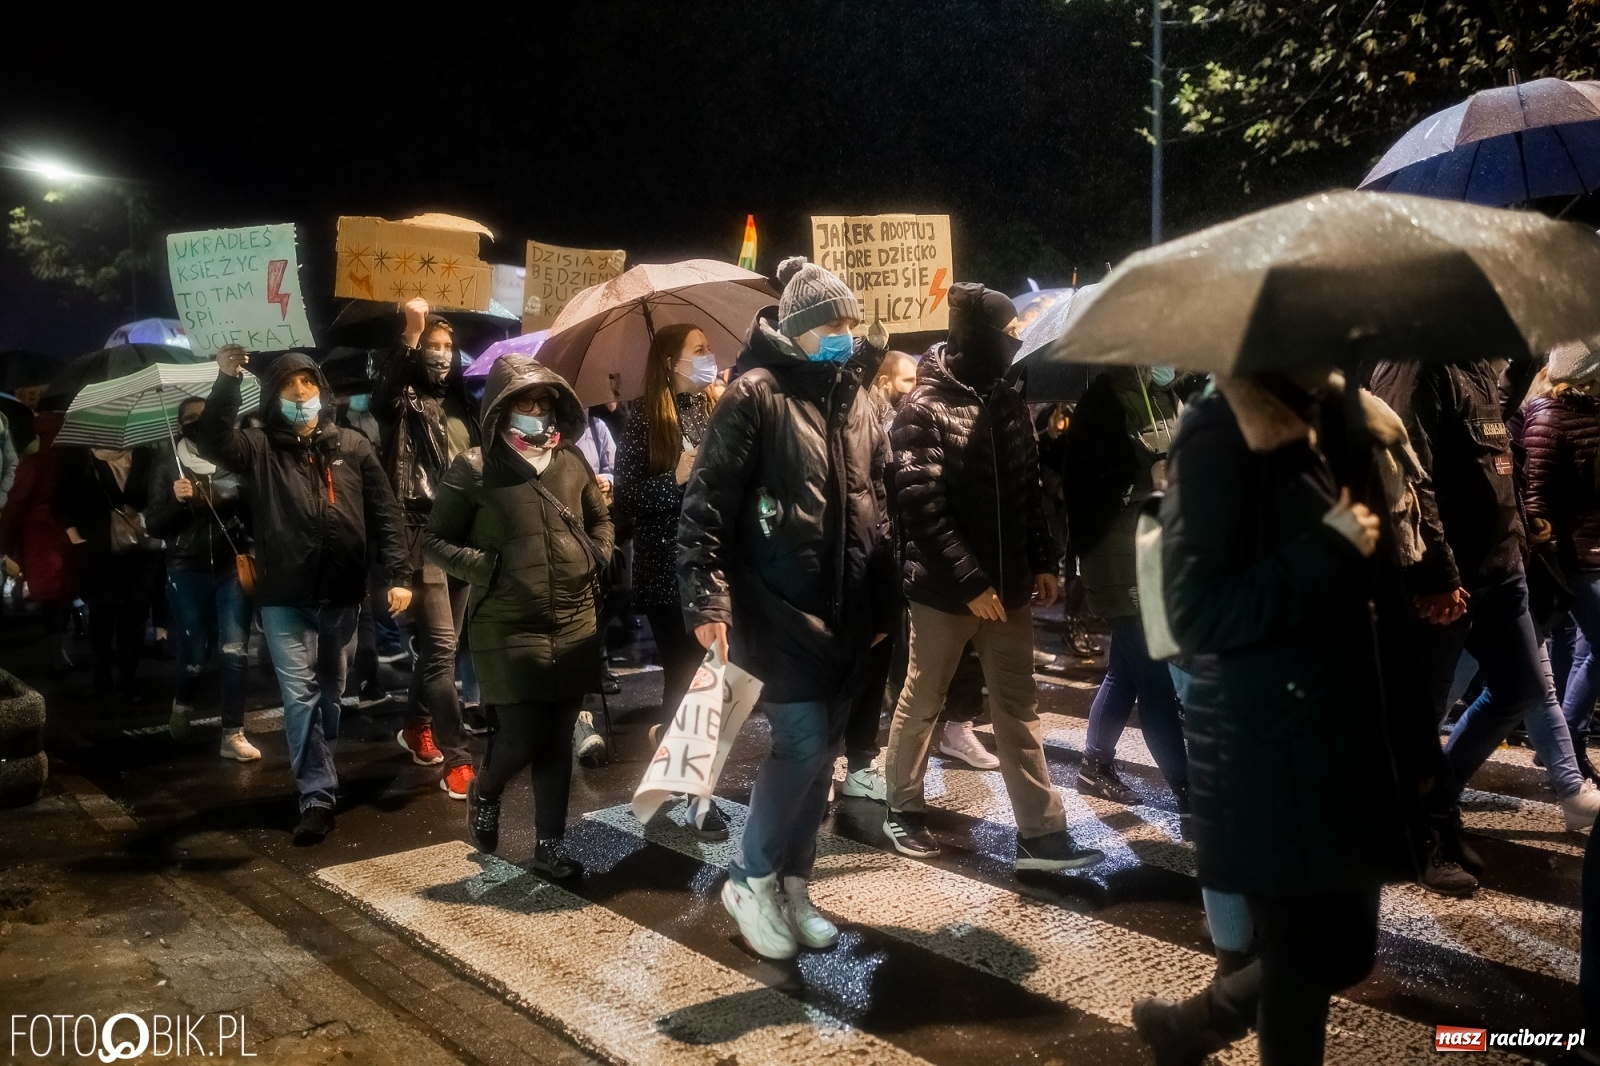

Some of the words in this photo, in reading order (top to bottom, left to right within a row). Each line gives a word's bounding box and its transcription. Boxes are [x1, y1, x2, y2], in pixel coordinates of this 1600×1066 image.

[173, 226, 272, 260] UKRADŁEŚ
[816, 222, 876, 250] JAREK
[880, 221, 936, 242] ADOPTUJ
[176, 255, 259, 284] KSIĘŻYC
[532, 246, 608, 270] DZISIAJ
[820, 248, 872, 272] CHORE
[877, 242, 937, 267] DZIECKO
[177, 290, 207, 309] TO
[210, 281, 254, 303] TAM
[874, 294, 928, 323] LICZY
[194, 324, 301, 351] UCIEKAJ
